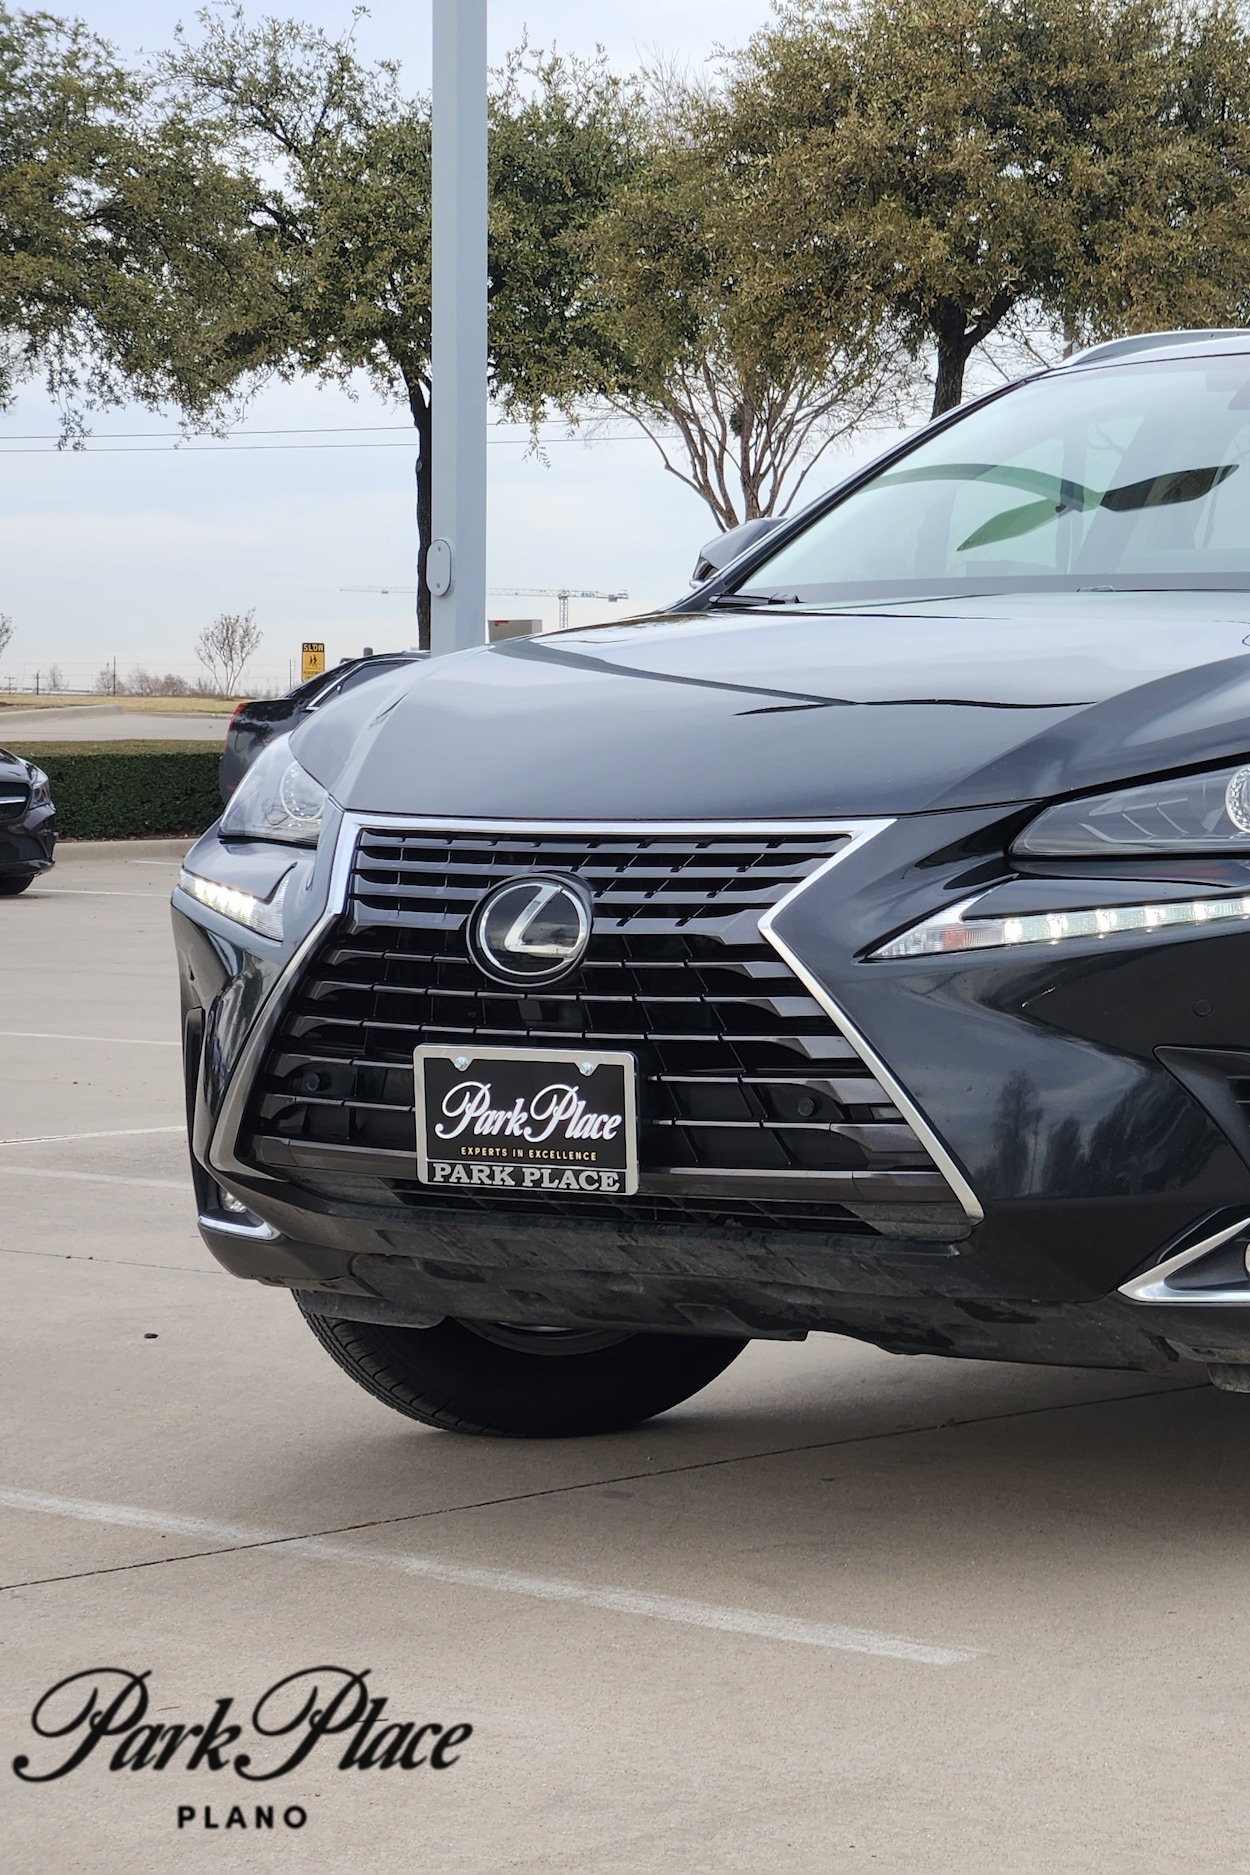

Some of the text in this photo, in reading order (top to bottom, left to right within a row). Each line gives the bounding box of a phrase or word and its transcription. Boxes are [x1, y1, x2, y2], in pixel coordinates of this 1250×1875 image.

[303, 644, 324, 652] SLOW
[434, 1080, 623, 1143] Park Place
[460, 1146, 598, 1162] EXPERTS IN EXCELLENCE
[432, 1163, 621, 1192] PARK PLACE
